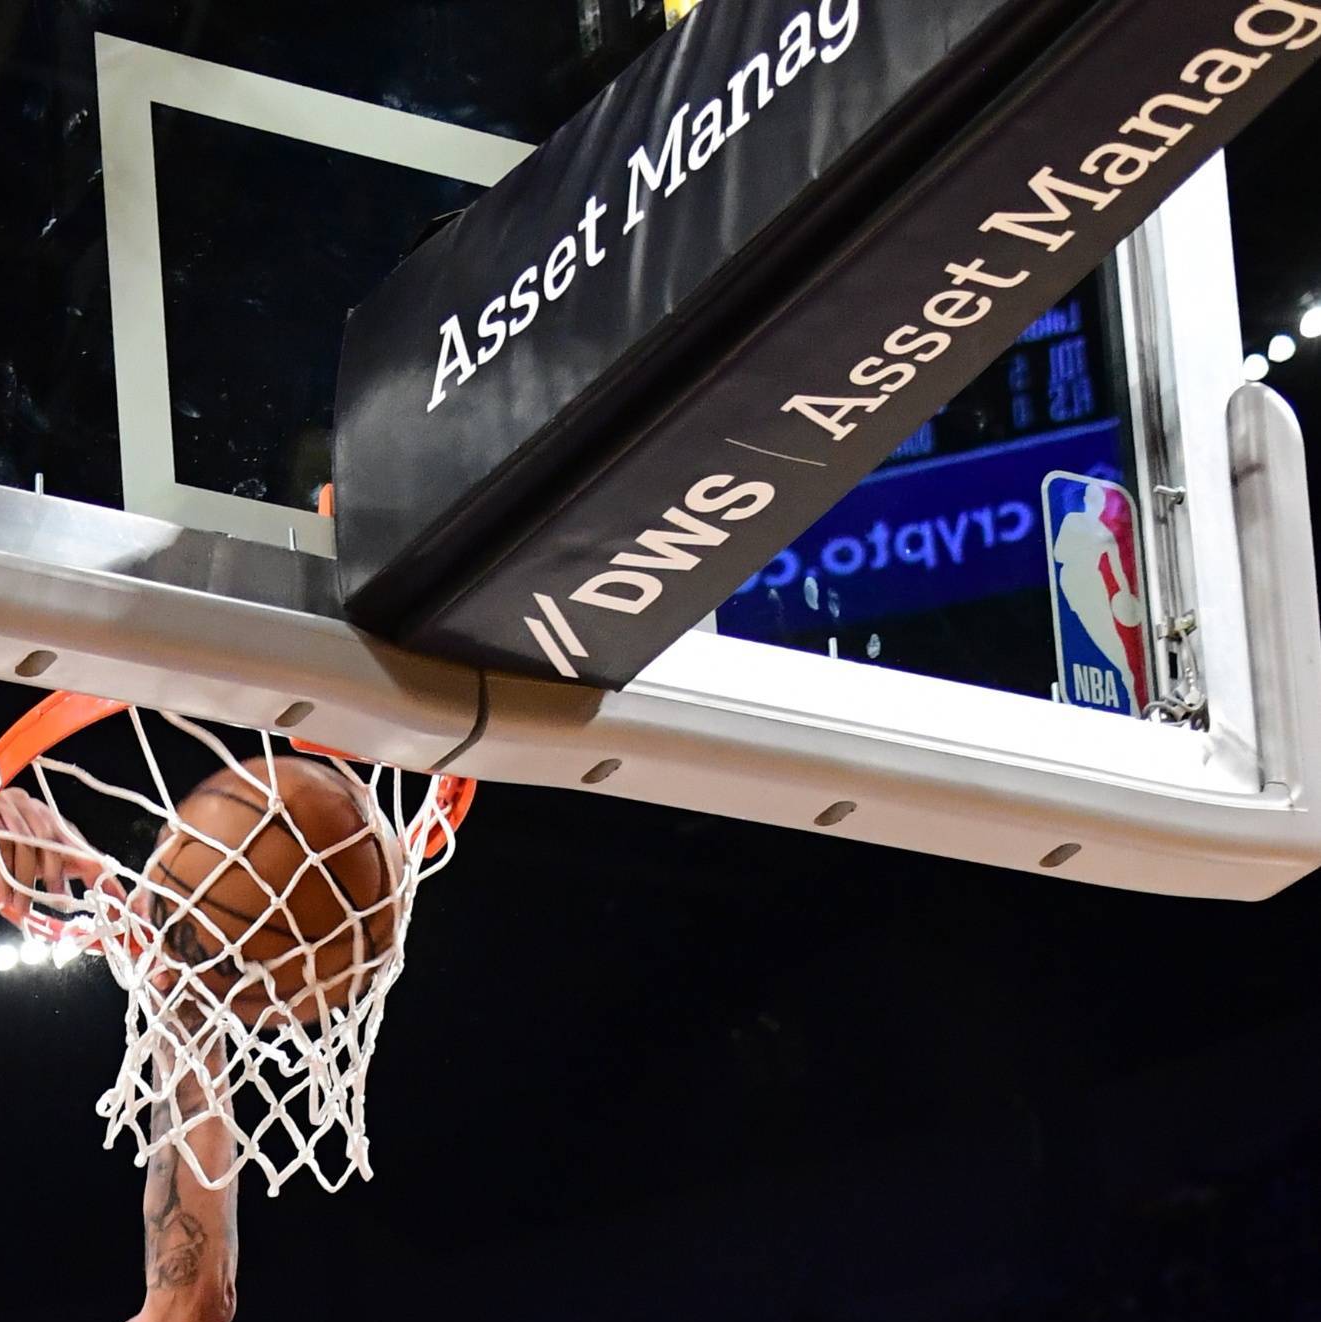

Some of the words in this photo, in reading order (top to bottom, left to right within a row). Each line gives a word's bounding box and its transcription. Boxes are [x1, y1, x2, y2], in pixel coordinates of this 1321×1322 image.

[427, 195, 607, 413] Asset
[622, 0, 859, 235] Manag
[568, 474, 775, 616] DWS
[780, 258, 1030, 441] Asset
[978, 0, 1321, 252] Manag
[1072, 662, 1120, 709] NBA
